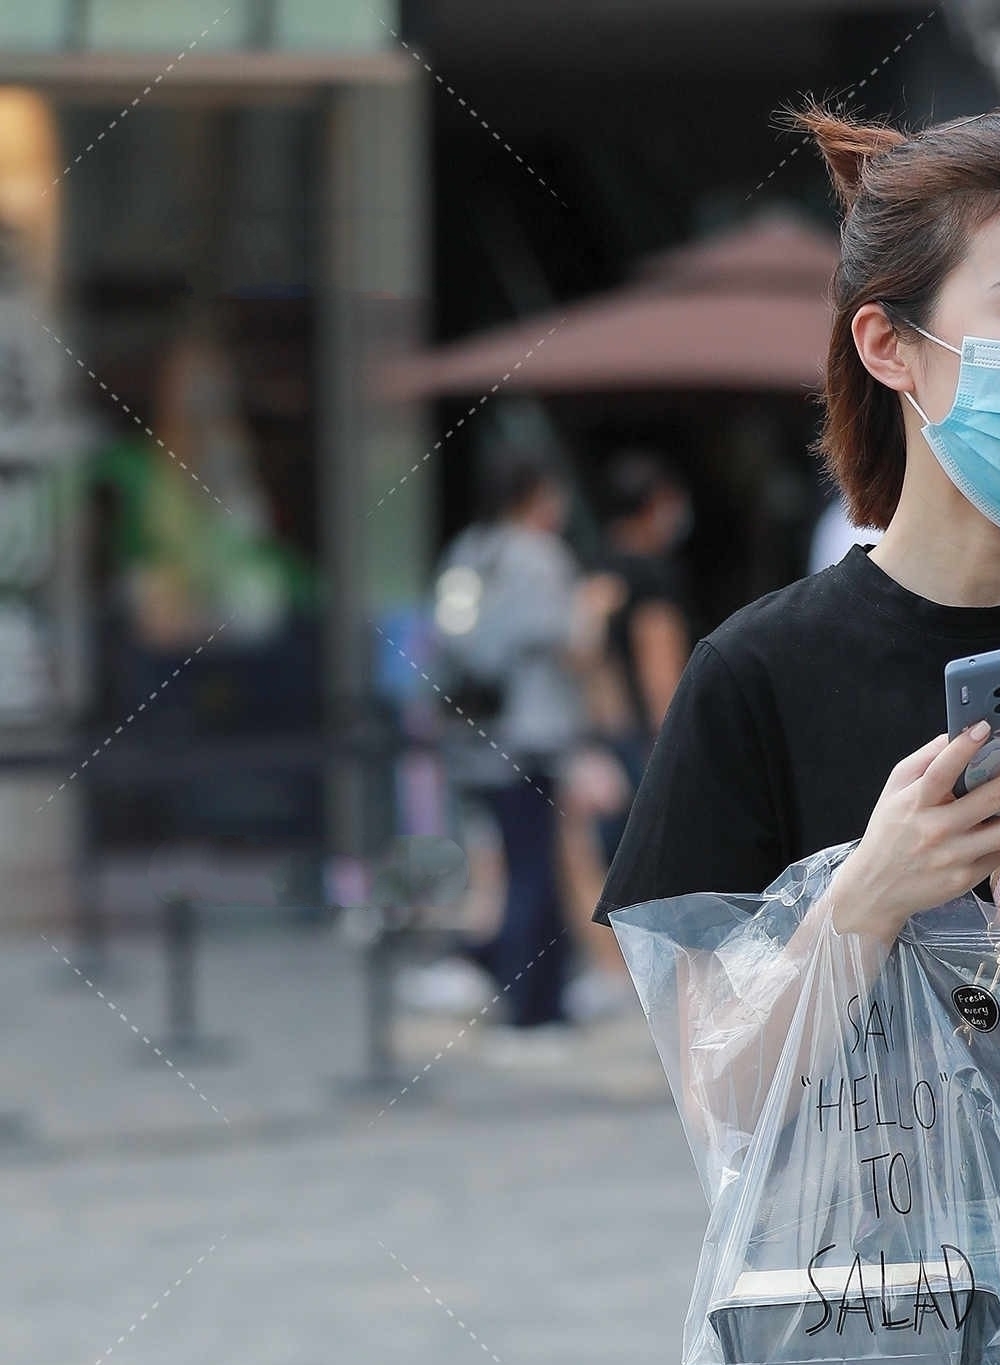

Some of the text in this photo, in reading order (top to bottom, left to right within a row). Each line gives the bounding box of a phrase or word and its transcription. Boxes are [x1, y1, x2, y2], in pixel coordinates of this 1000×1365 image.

[958, 992, 986, 1003] Fresh
[964, 1007, 989, 1016] every
[848, 994, 894, 1053] SAY
[971, 1017, 987, 1028] day
[861, 1152, 912, 1218] TO
[805, 1243, 976, 1336] SALAD
